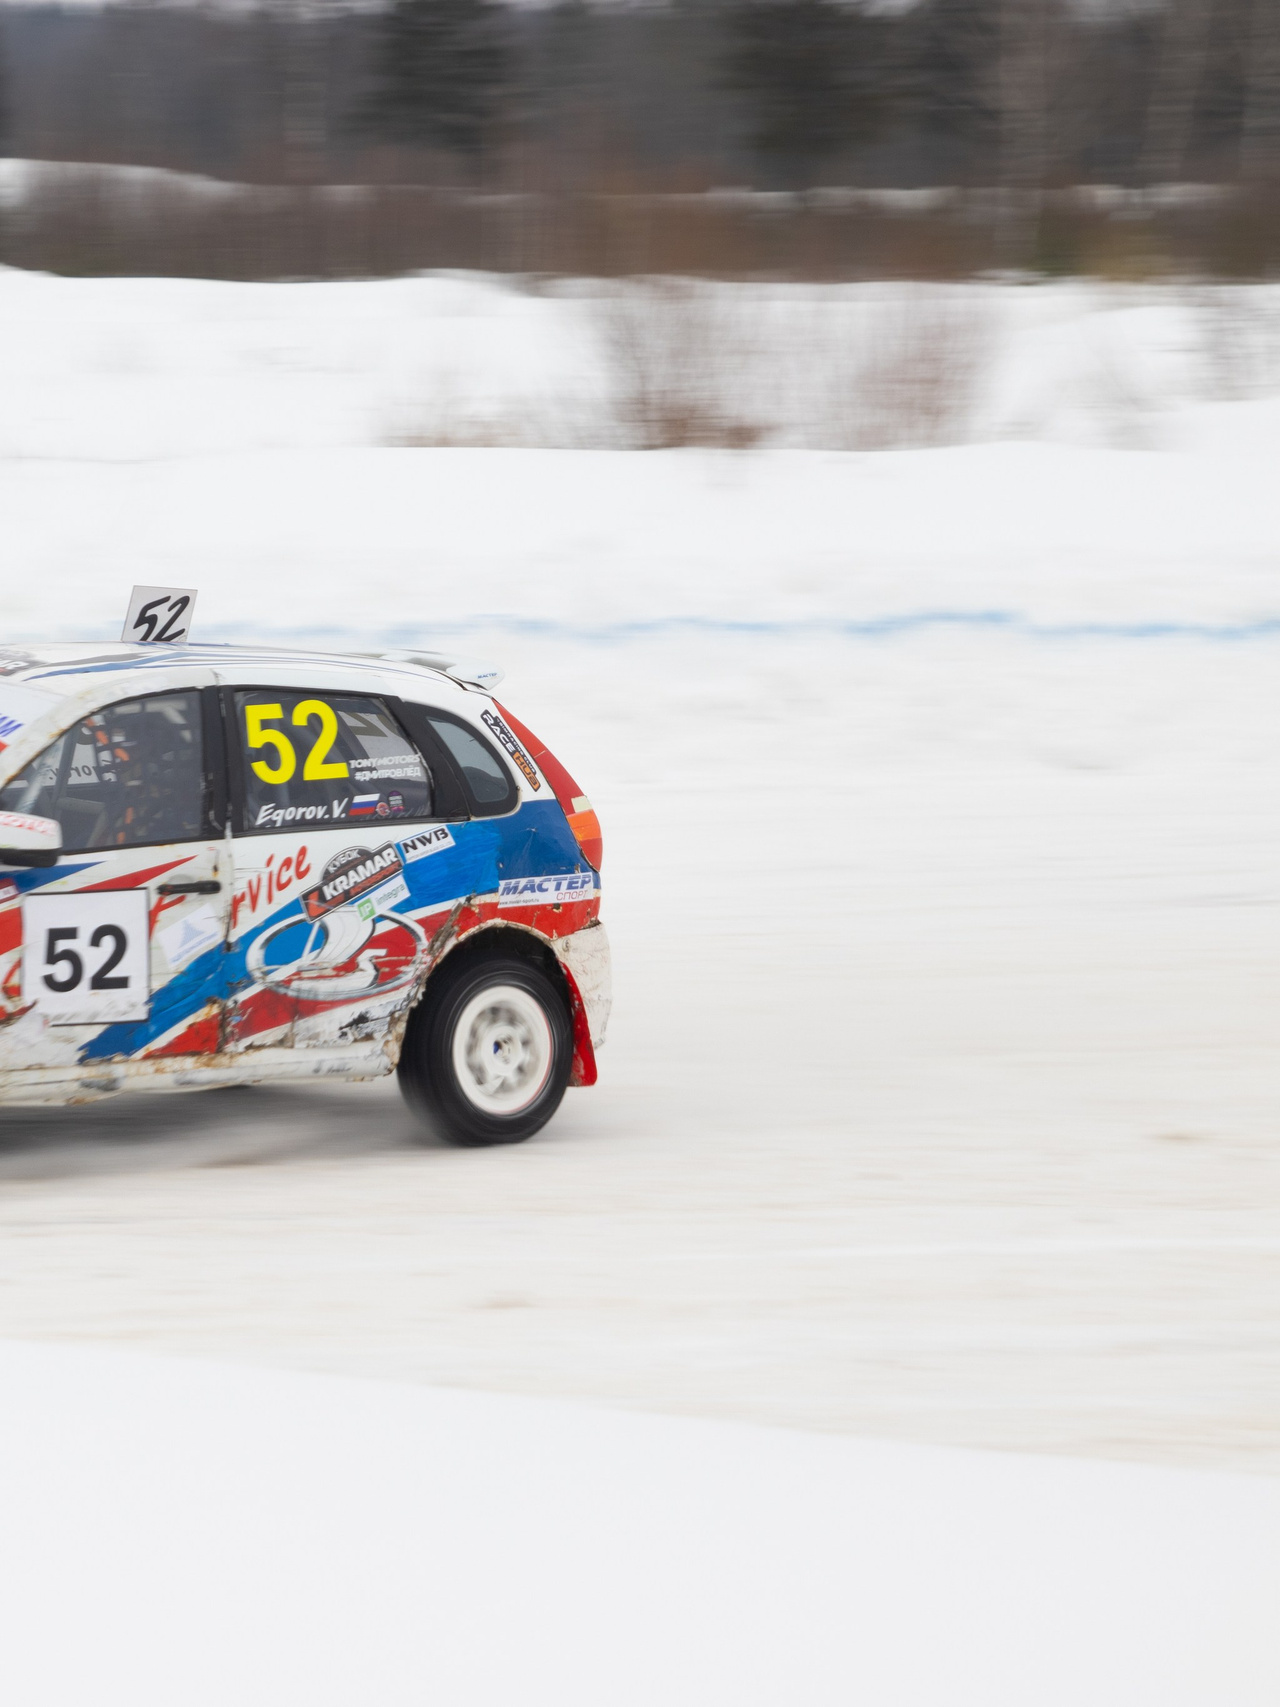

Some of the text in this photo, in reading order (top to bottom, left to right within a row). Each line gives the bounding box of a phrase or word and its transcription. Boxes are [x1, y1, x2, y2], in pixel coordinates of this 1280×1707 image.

[132, 595, 190, 642] 52
[244, 699, 350, 785] 52
[482, 713, 538, 786] RACE HUB
[402, 828, 449, 854] NWB
[322, 847, 398, 901] KRAMAR
[501, 874, 592, 896] МАСТЕР
[556, 889, 588, 901] СПОРТ
[42, 924, 130, 993] 52
